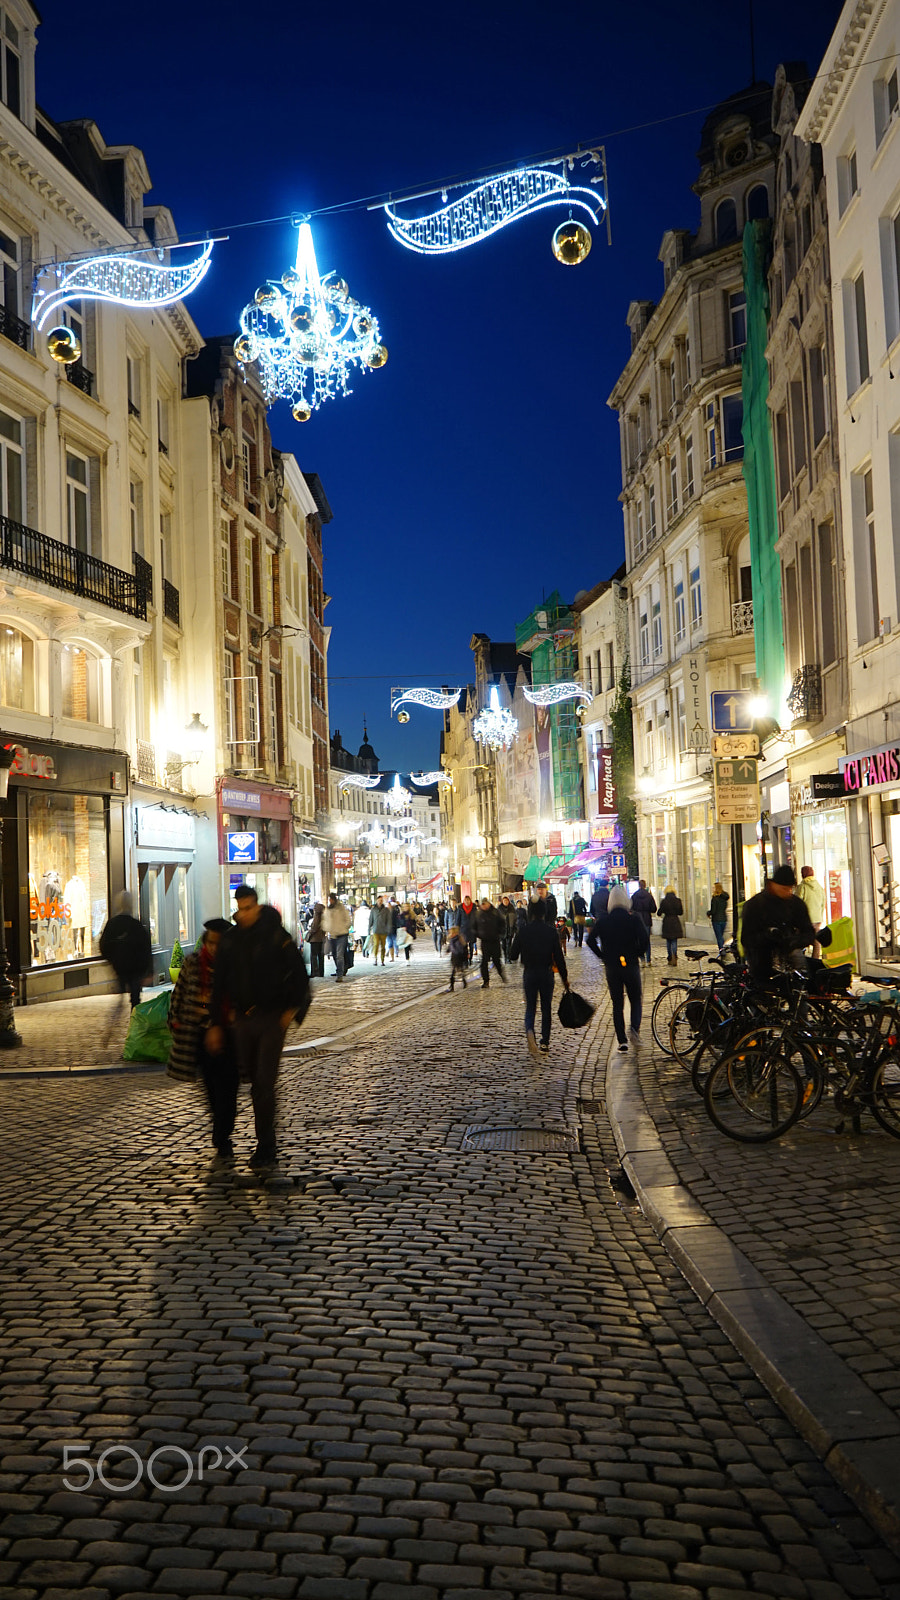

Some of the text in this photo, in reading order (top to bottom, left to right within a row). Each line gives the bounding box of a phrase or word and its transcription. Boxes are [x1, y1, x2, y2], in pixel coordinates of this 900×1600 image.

[689, 659, 700, 720] HOTEL
[9, 744, 55, 778] Store
[844, 748, 898, 791] ICI PARIS
[227, 791, 247, 802] ANTWERP
[247, 793, 260, 804] JEWELS
[602, 755, 615, 808] Raphael
[815, 782, 841, 790] Desigu
[30, 897, 72, 919] Soldes
